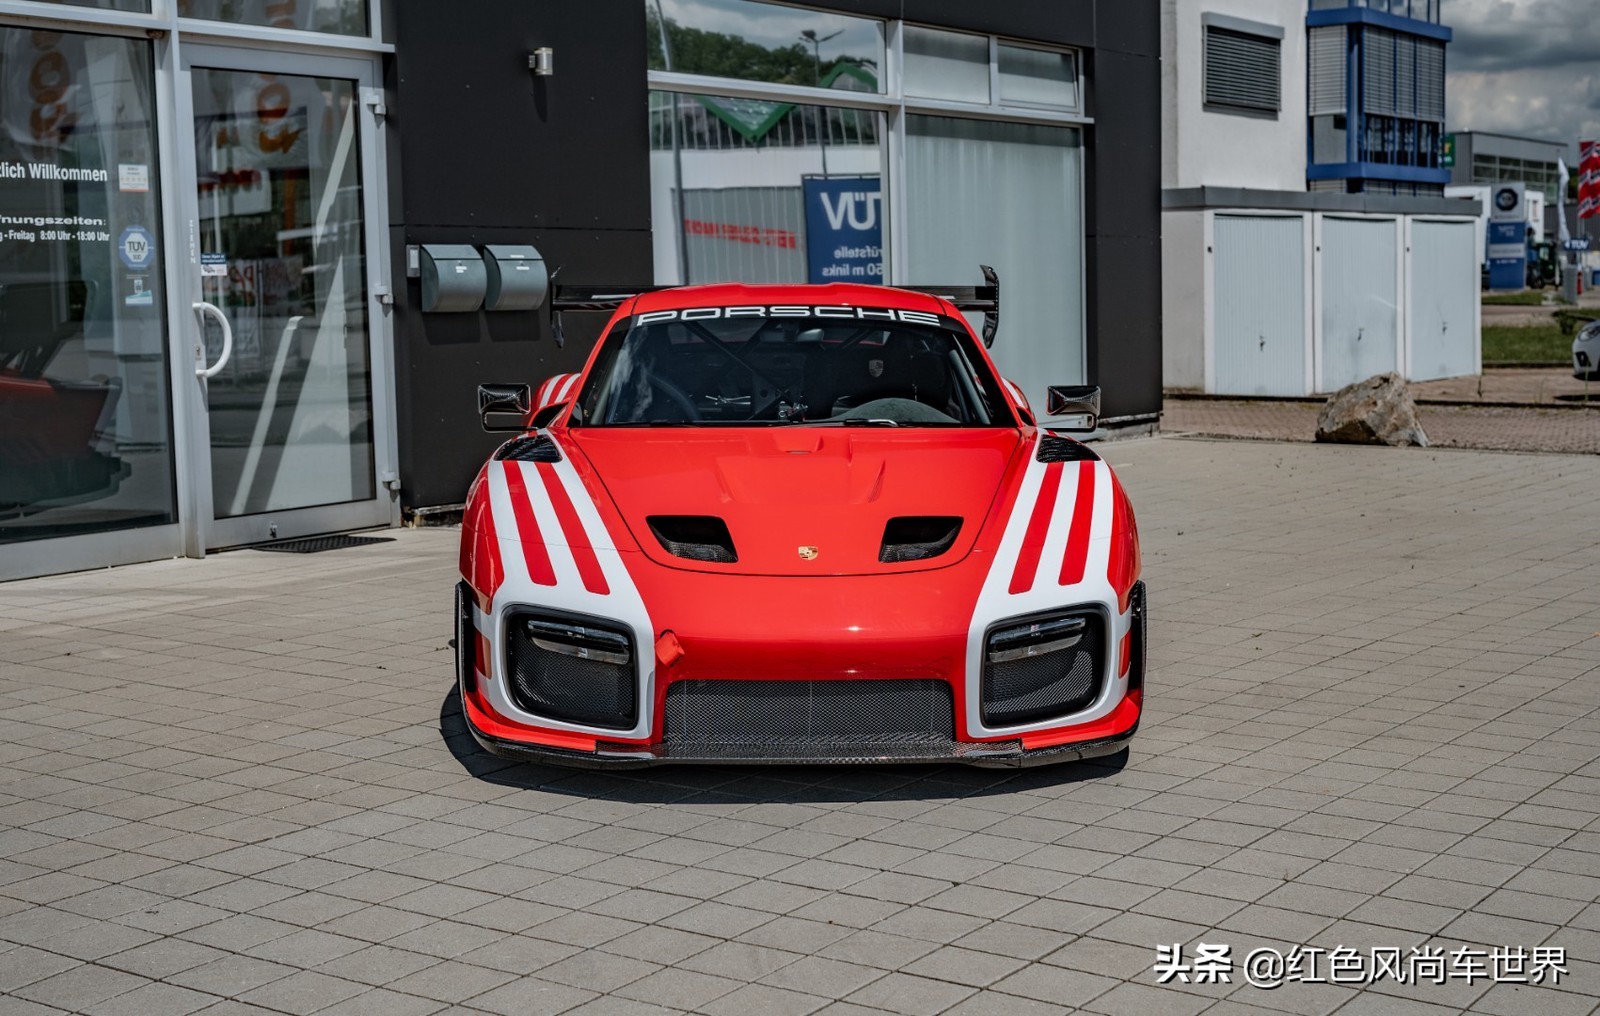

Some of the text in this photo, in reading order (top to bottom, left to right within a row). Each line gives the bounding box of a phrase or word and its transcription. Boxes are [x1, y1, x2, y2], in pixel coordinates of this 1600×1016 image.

[0, 162, 25, 178] lich
[28, 163, 107, 181] Willkommen
[9, 230, 35, 242] Freitag
[40, 230, 56, 240] 8:00
[57, 230, 71, 240] Uhr
[77, 231, 95, 241] 18:00
[97, 232, 110, 241] Uhr
[636, 306, 940, 326] PORSCHE
